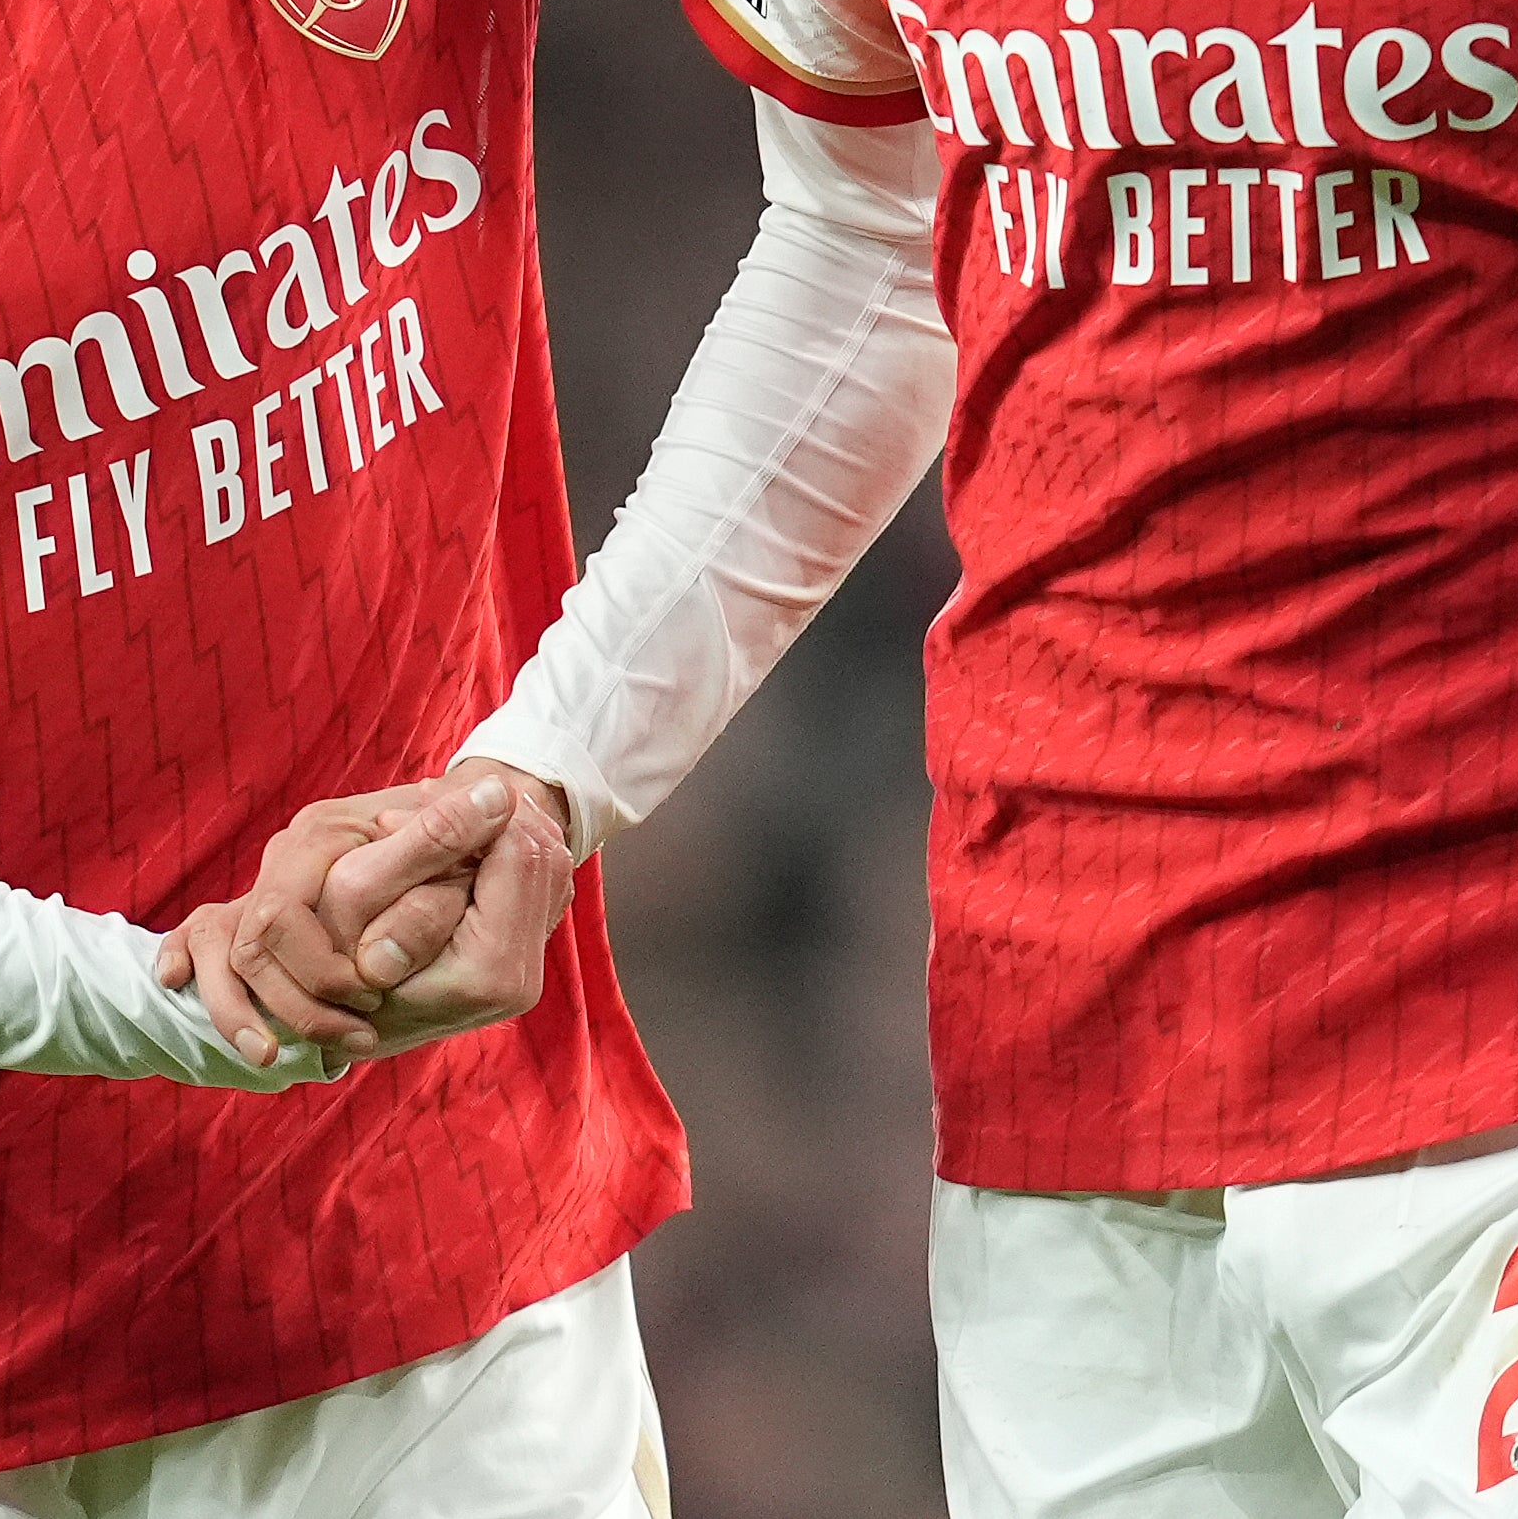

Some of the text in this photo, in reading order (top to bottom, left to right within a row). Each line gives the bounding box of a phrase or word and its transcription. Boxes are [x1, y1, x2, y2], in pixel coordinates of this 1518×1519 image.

[1106, 167, 1431, 287] BETTER
[14, 296, 445, 614] FLY BETTER
